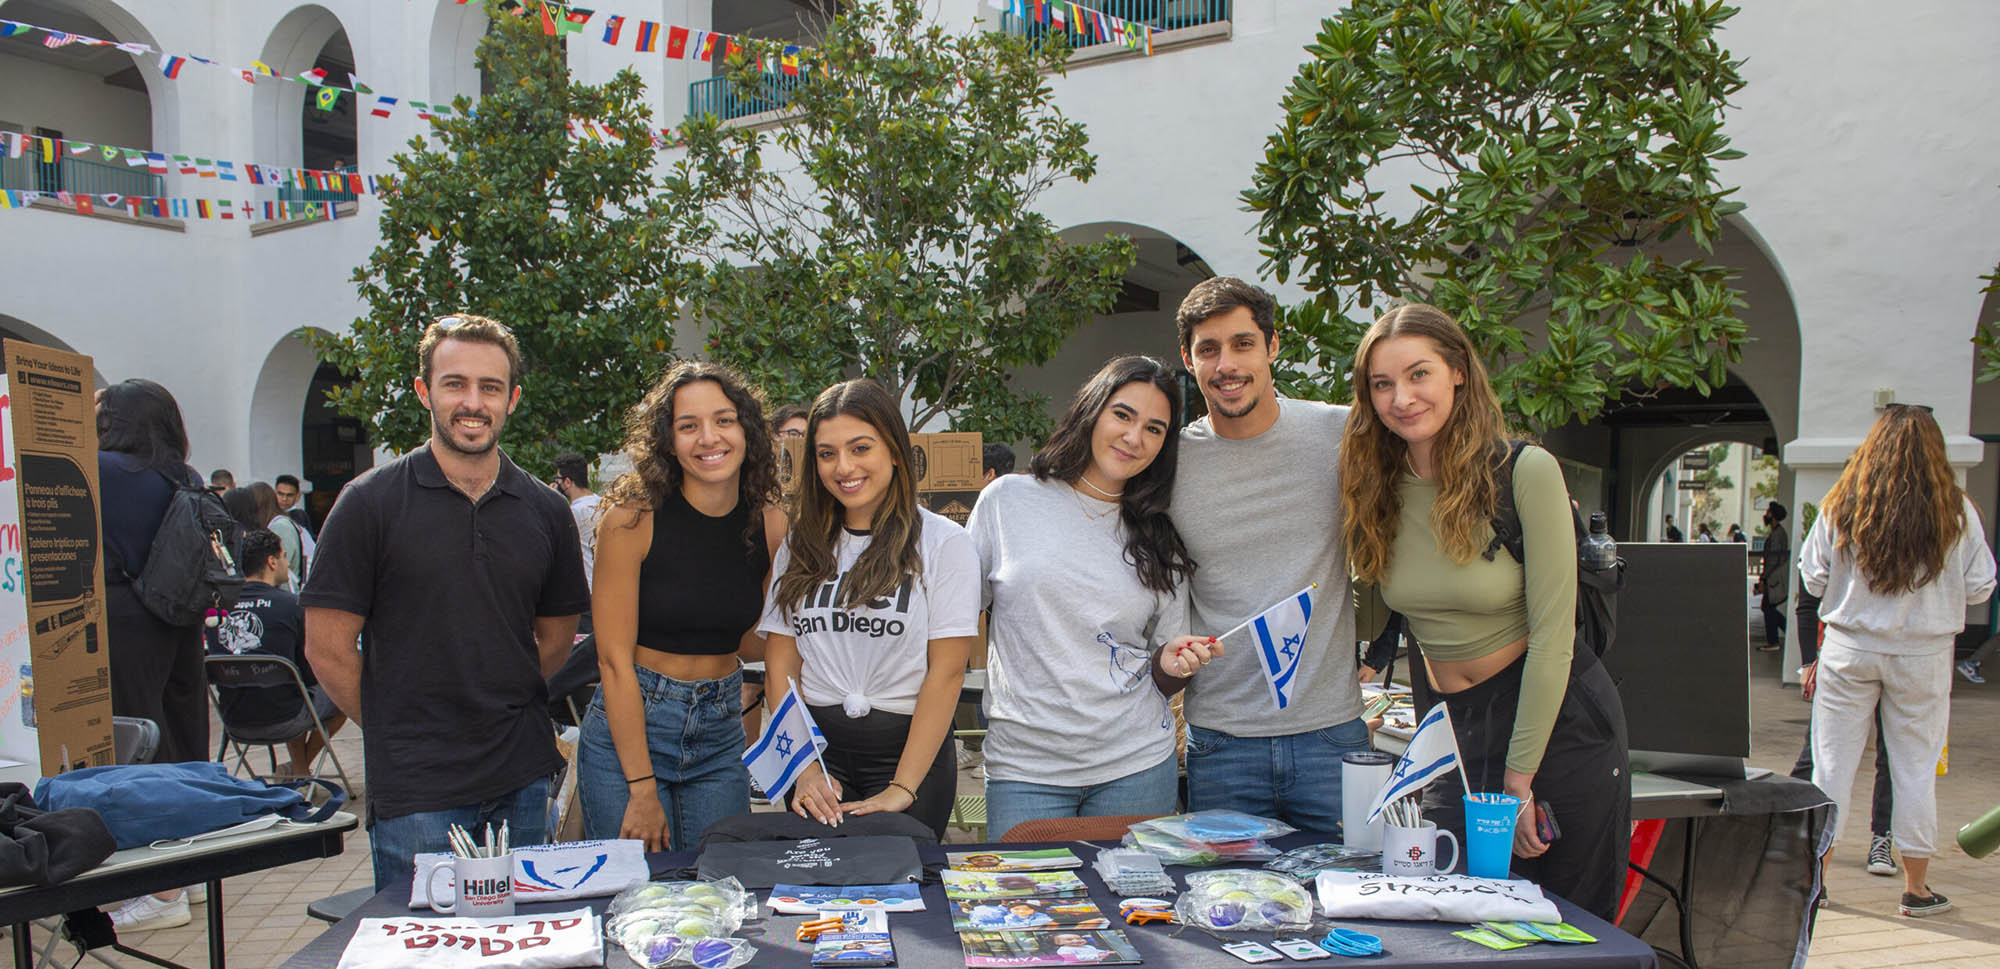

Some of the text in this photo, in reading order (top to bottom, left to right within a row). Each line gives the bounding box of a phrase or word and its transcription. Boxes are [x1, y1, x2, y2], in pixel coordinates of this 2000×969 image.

[32, 359, 48, 370] Your
[48, 361, 64, 373] Ideas
[792, 612, 905, 638] San Diego
[463, 875, 510, 895] Hillel
[986, 956, 1041, 964] RANYA
